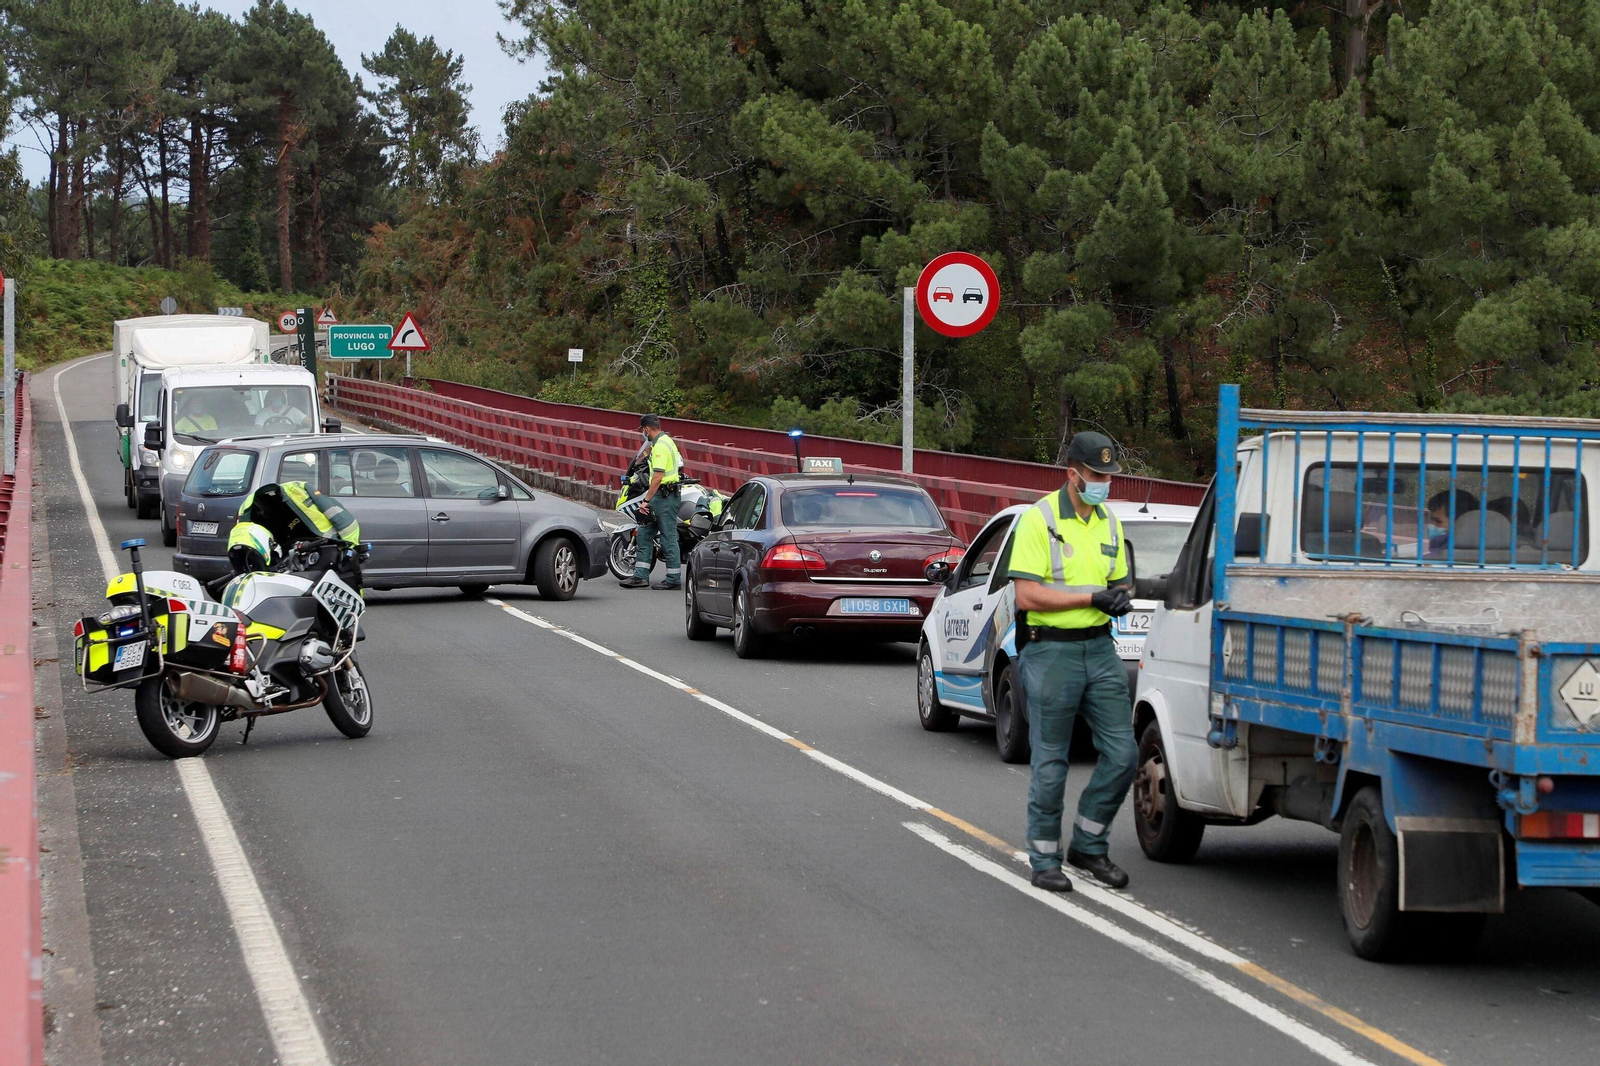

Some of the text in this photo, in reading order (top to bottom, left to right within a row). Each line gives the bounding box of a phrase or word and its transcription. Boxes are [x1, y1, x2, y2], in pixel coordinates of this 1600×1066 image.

[283, 318, 296, 326] 90
[347, 342, 376, 351] LUGO
[810, 459, 833, 467] TAXI
[850, 600, 907, 612] 1058 GXH
[1130, 614, 1154, 629] 42
[1578, 681, 1594, 696] LU
